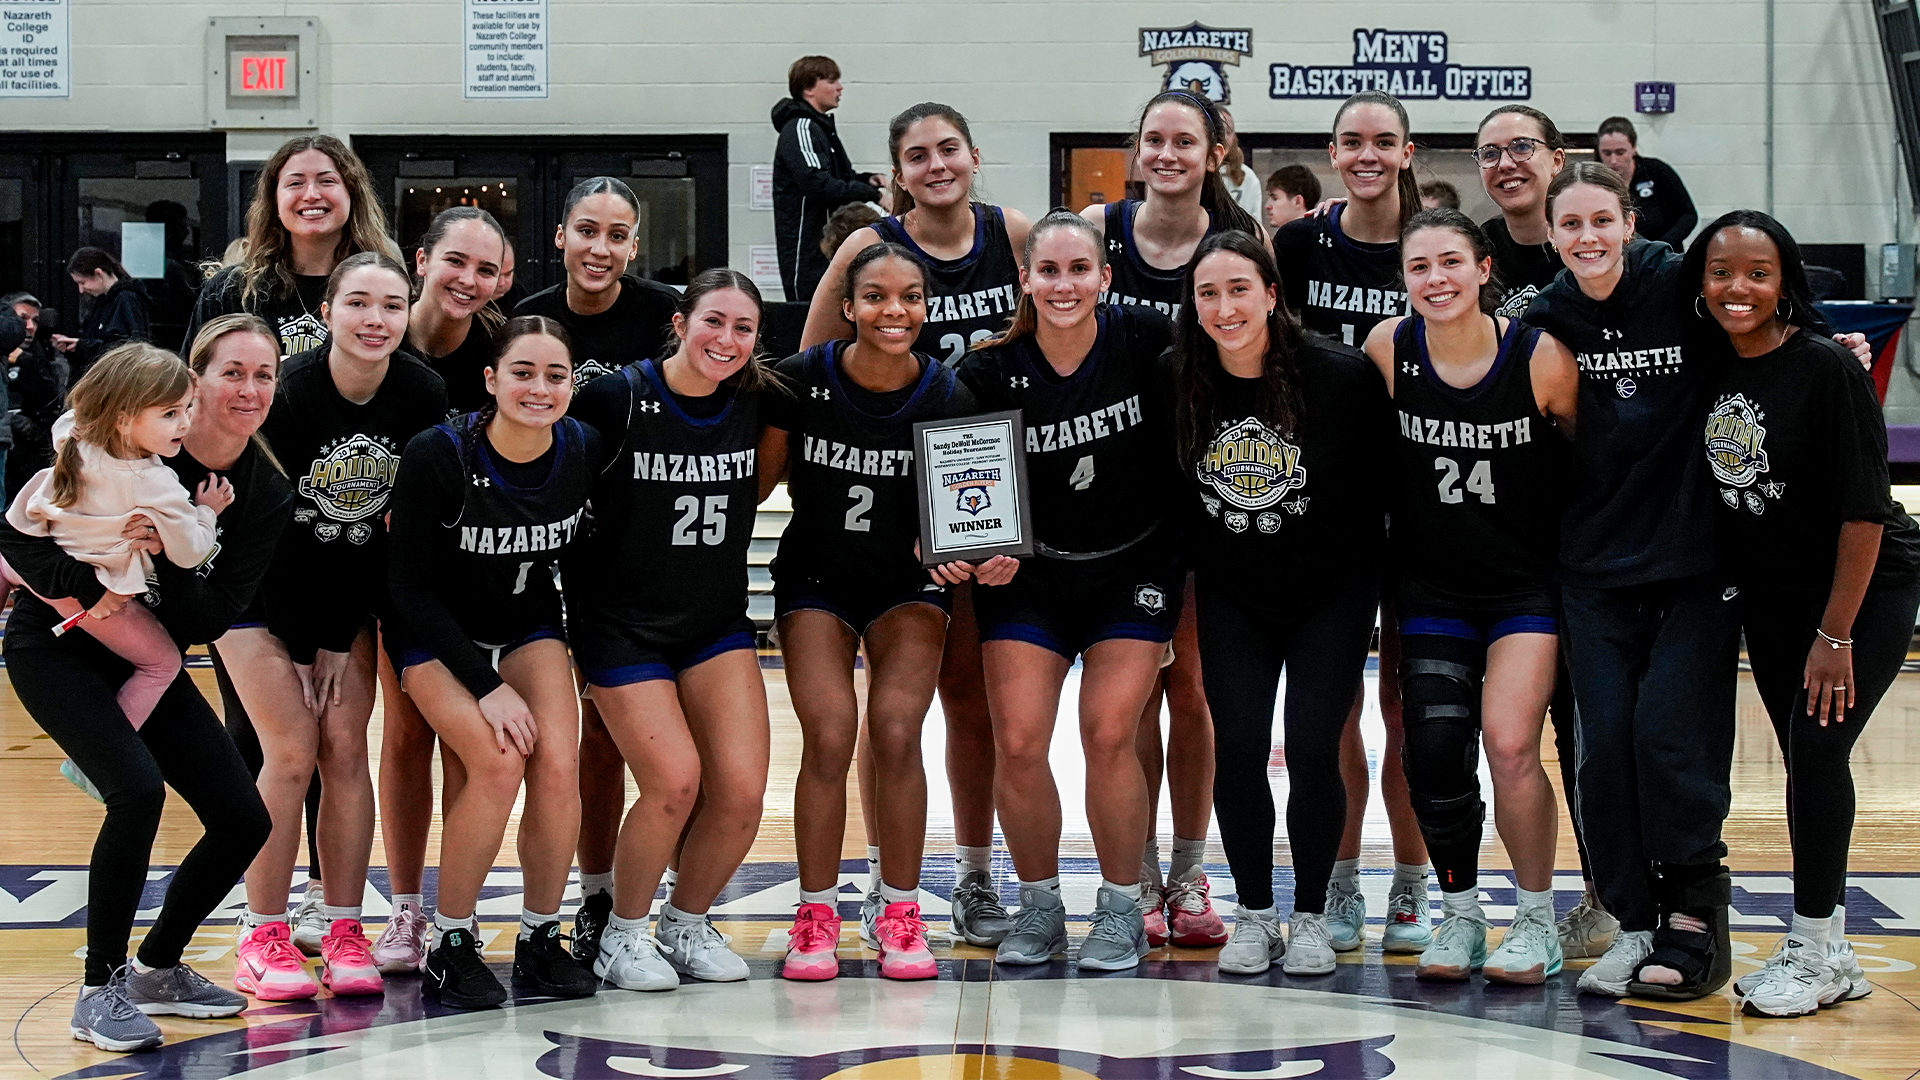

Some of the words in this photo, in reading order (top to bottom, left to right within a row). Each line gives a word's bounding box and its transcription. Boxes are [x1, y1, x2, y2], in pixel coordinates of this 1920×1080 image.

[3, 11, 52, 20] Nazareth
[473, 11, 494, 19] These
[495, 11, 526, 19] facilities
[7, 22, 49, 34] College
[472, 22, 503, 30] available
[531, 21, 540, 31] by
[22, 34, 34, 43] ID
[476, 32, 507, 40] Nazareth
[509, 31, 536, 41] College
[1143, 31, 1249, 52] NAZARETH
[0, 46, 8, 55] s
[11, 46, 58, 56] required
[469, 43, 508, 52] community
[511, 42, 543, 50] members
[1156, 49, 1199, 61] GOLDEN
[1201, 48, 1235, 61] FLYERS
[11, 57, 25, 66] all
[28, 57, 58, 66] times
[2, 69, 17, 78] for
[21, 70, 41, 78] use
[43, 69, 55, 78] of
[242, 57, 287, 90] EXIT
[0, 80, 8, 89] ll
[11, 80, 62, 90] facilities.
[469, 84, 506, 92] recreation
[508, 84, 543, 92] members.
[924, 284, 1016, 323] ZARETH
[1307, 280, 1412, 317] NAZARET
[1026, 394, 1143, 452] AZARETH
[1398, 410, 1531, 449] NAZARETH
[1229, 432, 1239, 440] 20
[933, 442, 951, 451] Sandy
[942, 448, 962, 456] Holiday
[963, 445, 996, 454] Tournament
[804, 433, 914, 476] NAZARET
[1206, 439, 1297, 477] HOLIDAY
[310, 456, 400, 487] HOLIDAY
[633, 448, 755, 482] NAZARETH
[1226, 465, 1274, 476] TOURNAMENT
[944, 470, 1000, 486] NAZARETH
[1069, 455, 1096, 491] 4
[332, 480, 377, 491] TOURNAMENT
[1434, 457, 1496, 504] 24
[844, 485, 874, 532] 2
[671, 495, 729, 546] 25
[949, 518, 1002, 534] WINNER
[512, 562, 534, 595] 1
